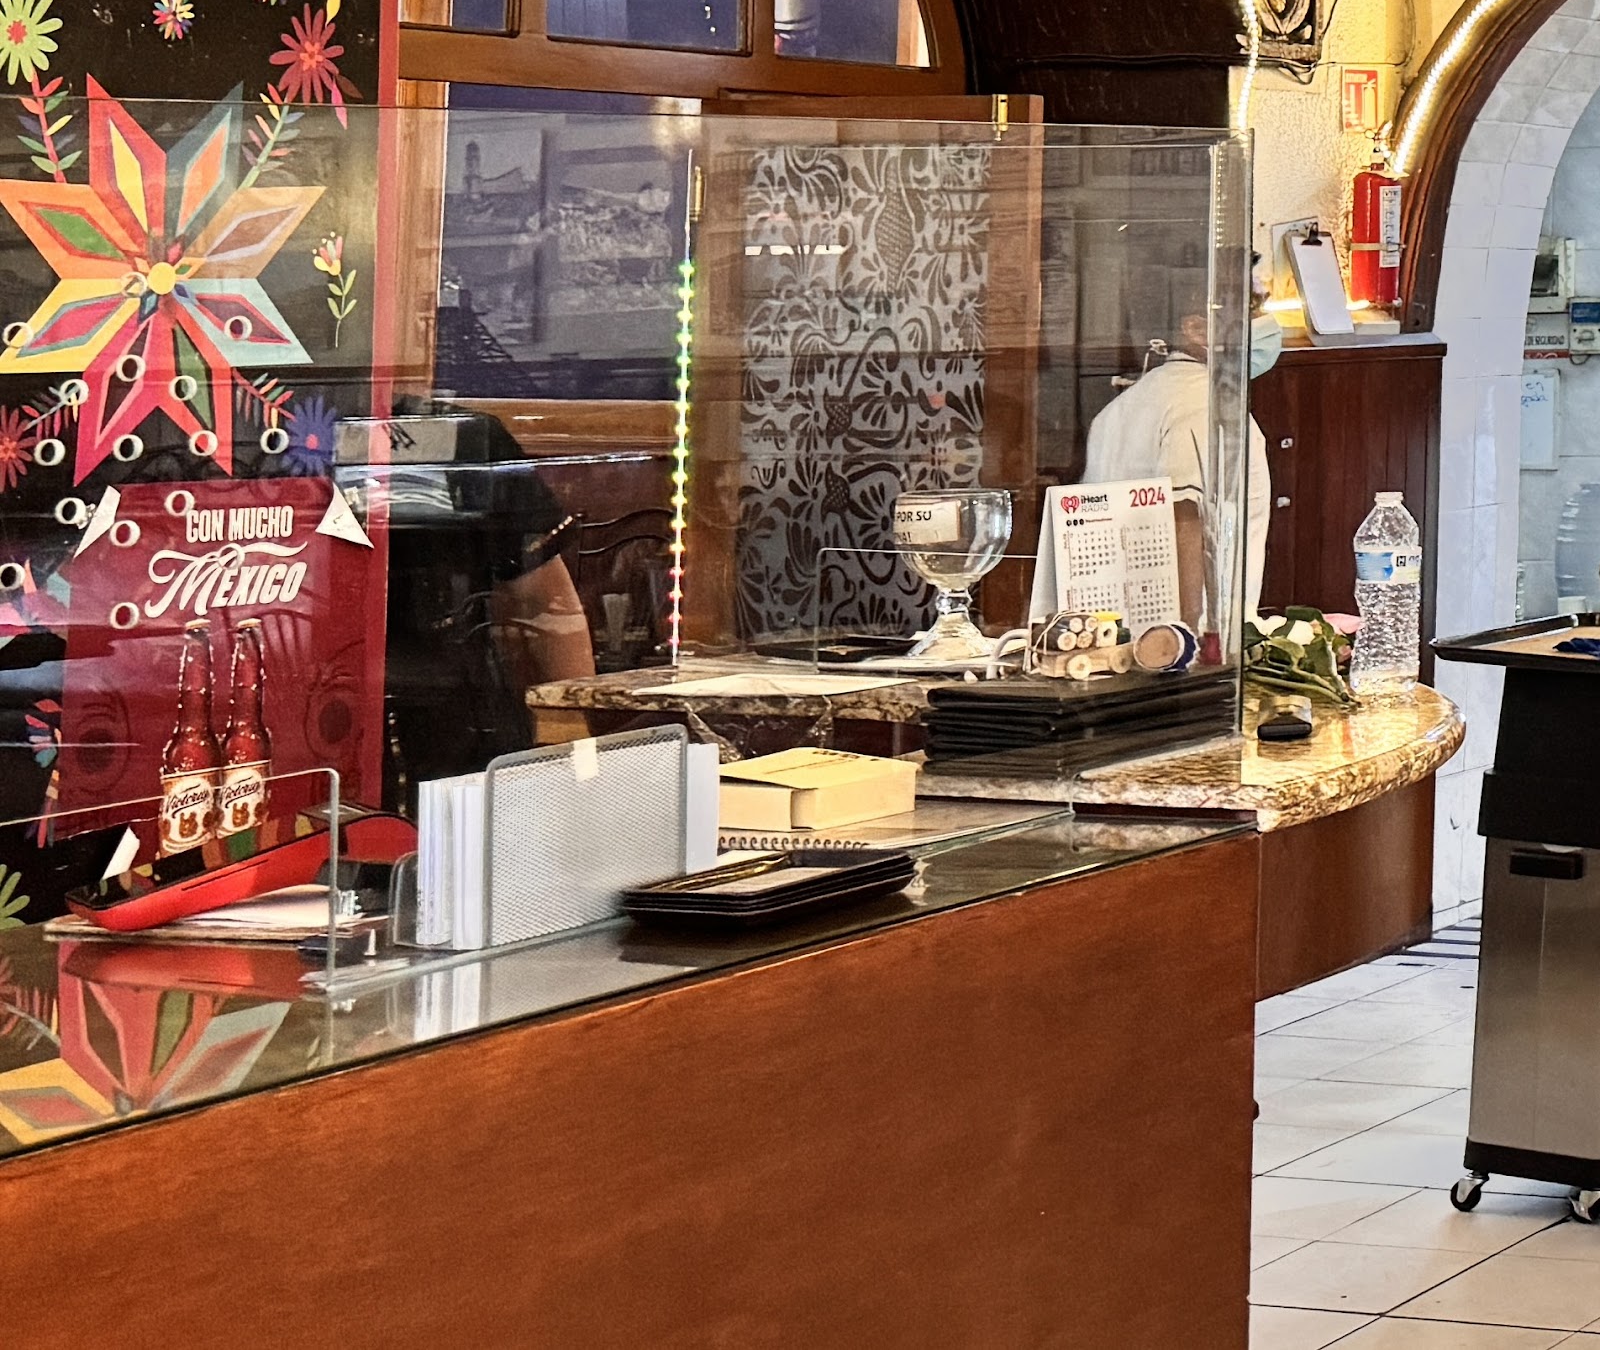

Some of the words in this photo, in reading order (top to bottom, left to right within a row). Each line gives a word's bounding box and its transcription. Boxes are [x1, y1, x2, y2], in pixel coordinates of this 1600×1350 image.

[1080, 493, 1108, 505] iHeart
[1129, 486, 1166, 508] 2024
[1081, 502, 1110, 513] RADIO
[186, 509, 225, 544] CON
[228, 505, 294, 542] MUCHO
[896, 511, 914, 523] POR
[916, 510, 932, 521] SU
[166, 783, 210, 819] Victoria
